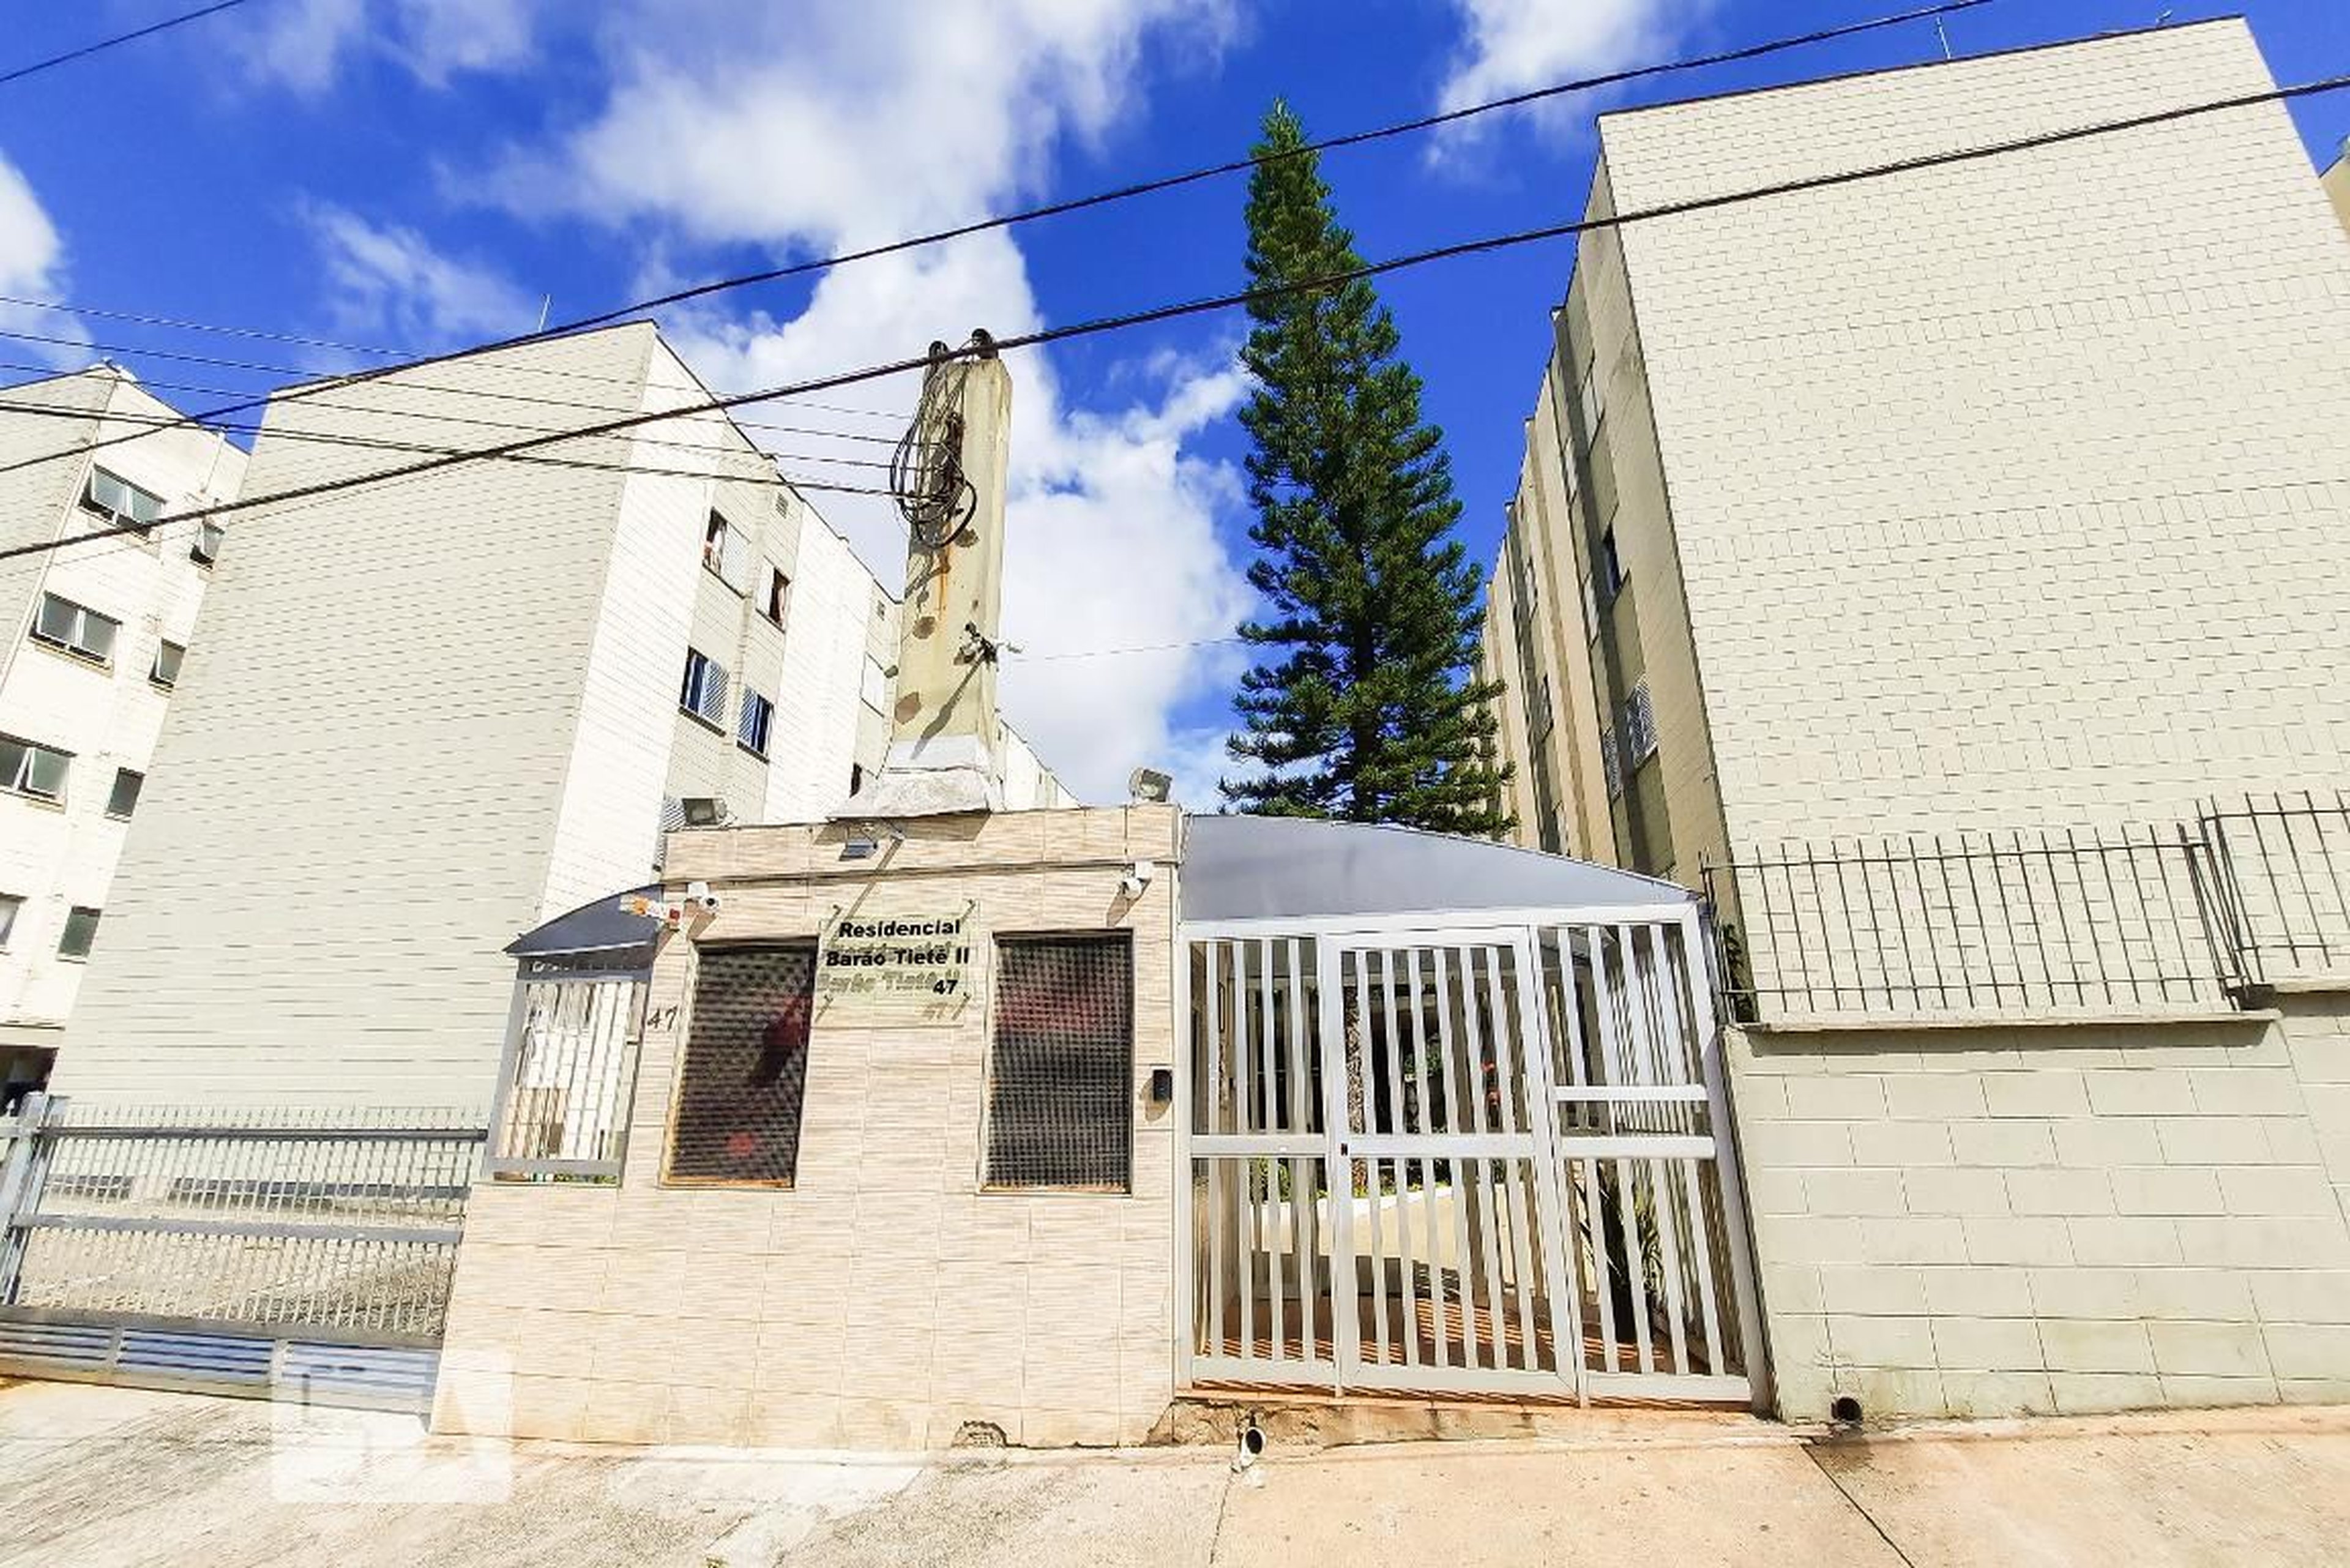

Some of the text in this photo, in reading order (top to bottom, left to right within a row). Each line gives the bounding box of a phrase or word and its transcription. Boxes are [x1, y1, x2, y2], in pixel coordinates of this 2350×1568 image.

[839, 919, 960, 938] Residencial
[956, 947, 969, 964] II
[933, 979, 958, 995] 47
[647, 1005, 678, 1031] 47
